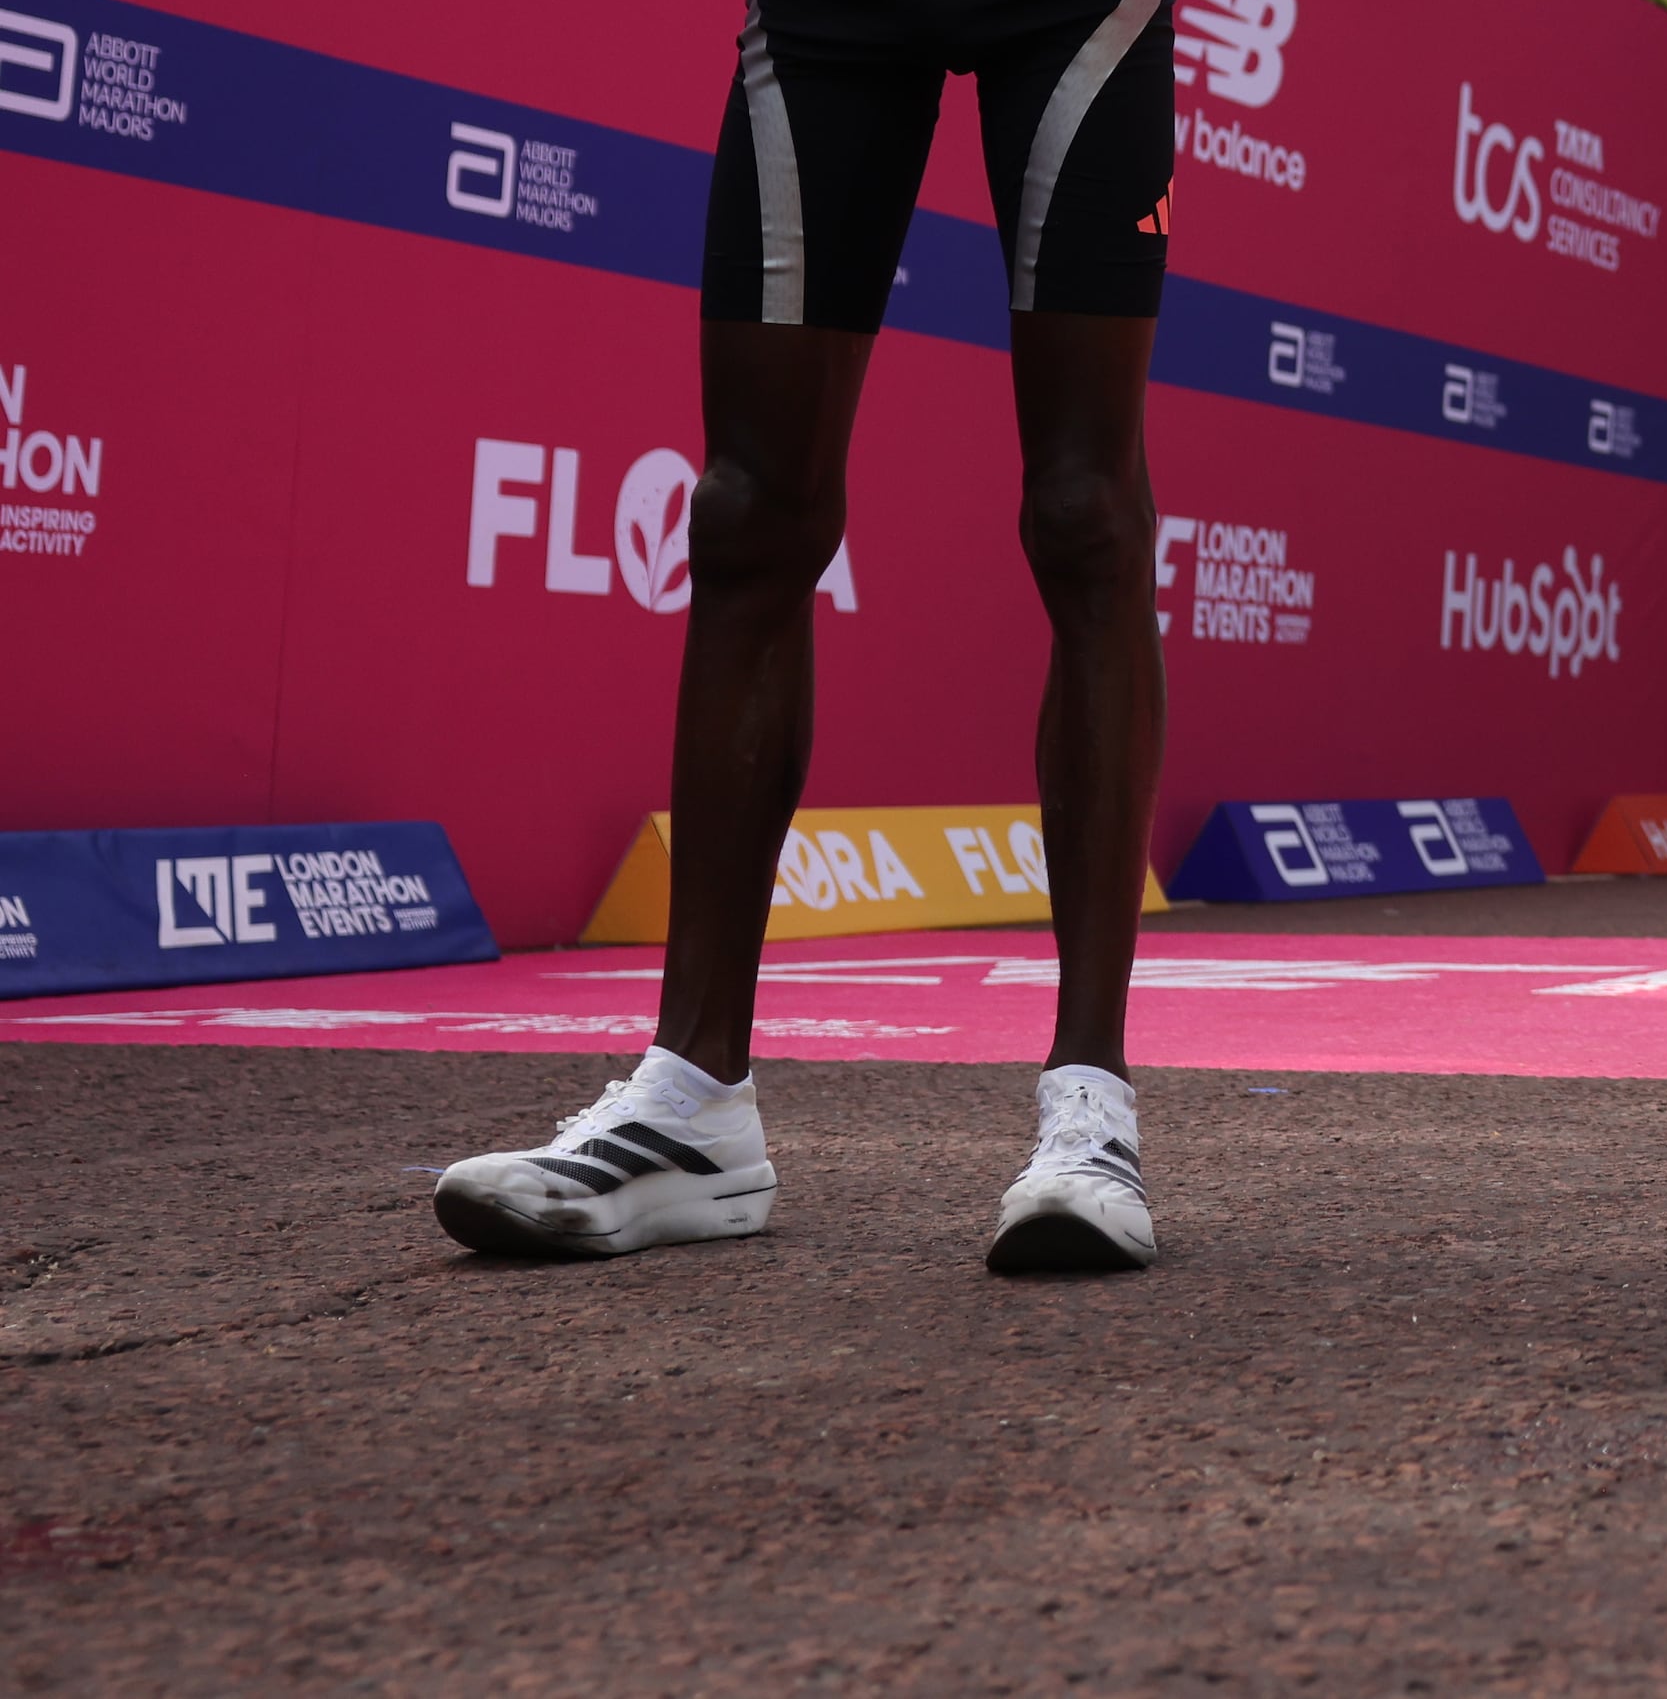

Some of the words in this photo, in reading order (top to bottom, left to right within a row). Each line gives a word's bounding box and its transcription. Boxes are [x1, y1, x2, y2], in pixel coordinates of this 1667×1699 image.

[85, 31, 162, 70] ABBOTT
[82, 55, 155, 92] WORLD
[78, 104, 155, 142] MAJORS
[80, 80, 187, 125] MARATHON
[520, 140, 577, 170] ABBOTT
[1195, 108, 1306, 191] balance
[1454, 81, 1545, 242] tcs
[1554, 118, 1605, 174] TATA
[518, 160, 573, 189] WORLD
[515, 203, 574, 232] MAJORS
[516, 181, 598, 217] MARATHON
[1550, 166, 1662, 239] CONSULTANCY
[1546, 214, 1620, 272] SERVICES
[1196, 520, 1288, 567] LONDON
[1194, 559, 1316, 610] MARATHON
[1192, 599, 1272, 644] EVENTS
[1441, 545, 1622, 678] HubSpot
[274, 850, 384, 882] LONDON
[284, 874, 431, 911] MARATHON
[298, 906, 393, 940] EVENTS
